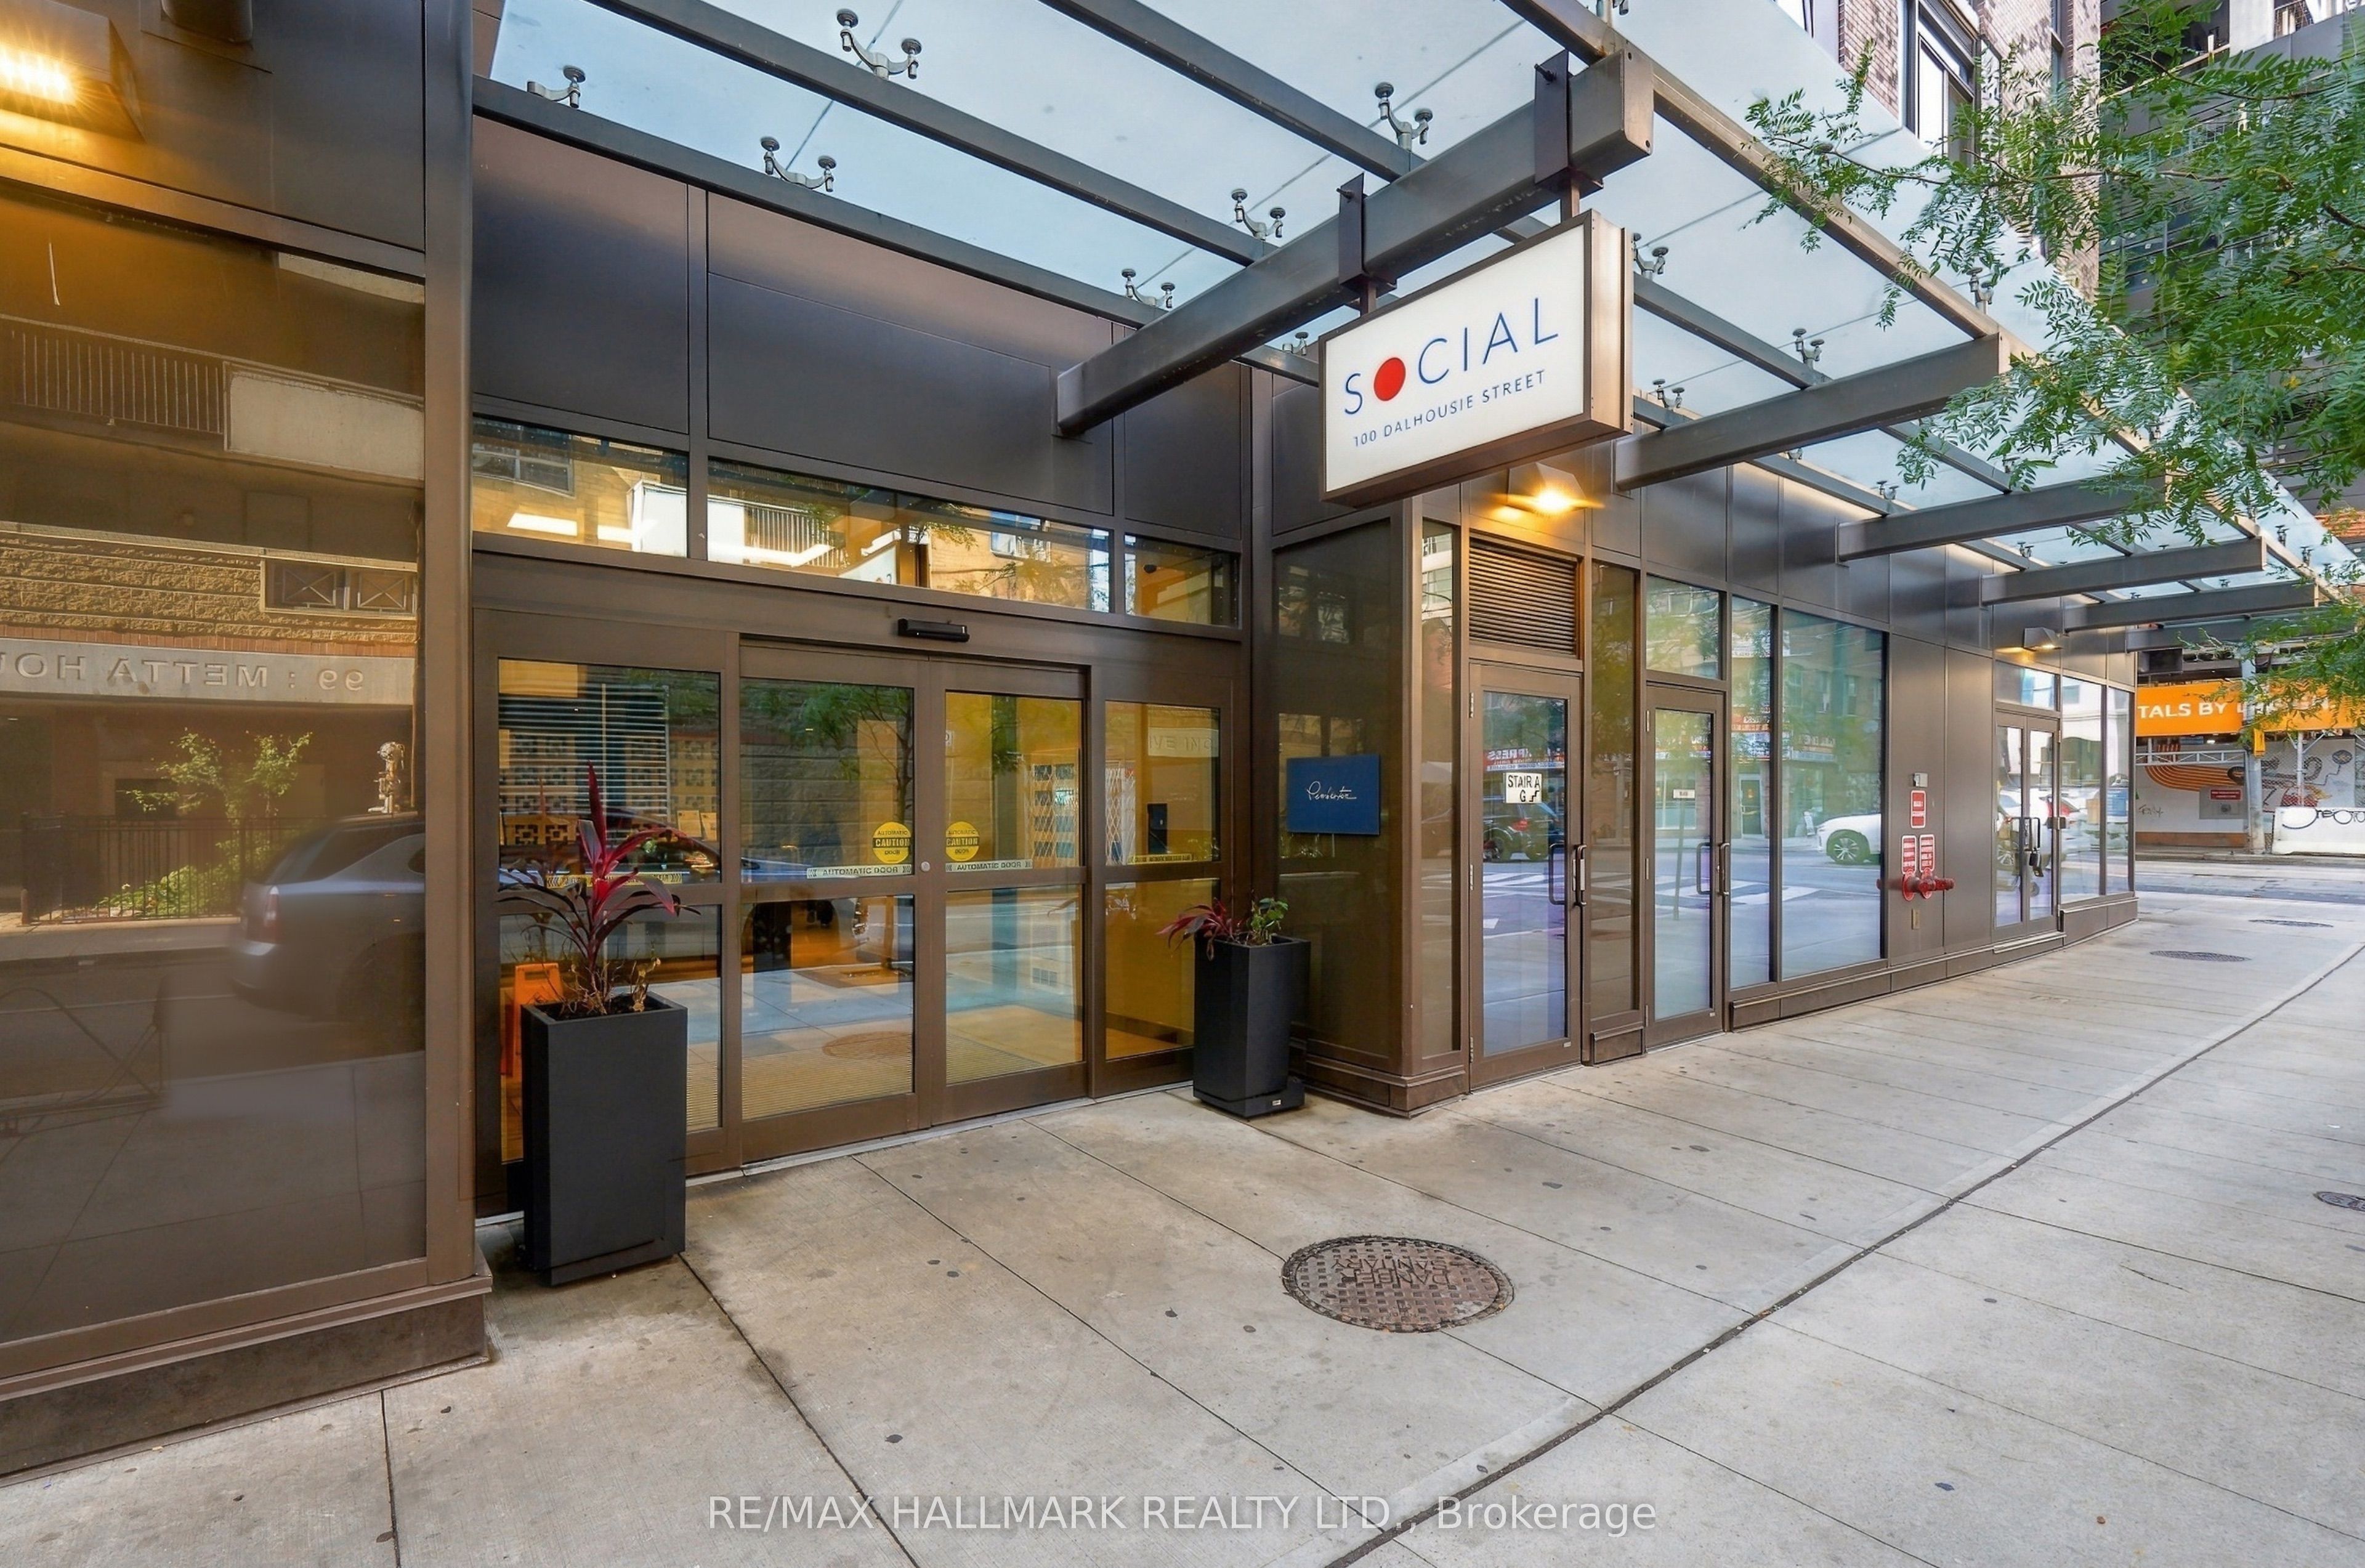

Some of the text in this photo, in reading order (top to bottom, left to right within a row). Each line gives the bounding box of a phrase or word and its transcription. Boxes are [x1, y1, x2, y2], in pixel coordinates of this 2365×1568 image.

[1354, 370, 1545, 448] 100 DALHOUSIE STREET
[2137, 703, 2191, 719] TALS
[2199, 702, 2228, 716] BY
[1508, 775, 1540, 788] STAIR A
[1519, 790, 1526, 802] G
[875, 838, 910, 847] CAUTION
[946, 838, 978, 846] CAUTION
[823, 866, 899, 876] AUTOMATIC DOOR
[957, 862, 998, 871] AUTOMATIC
